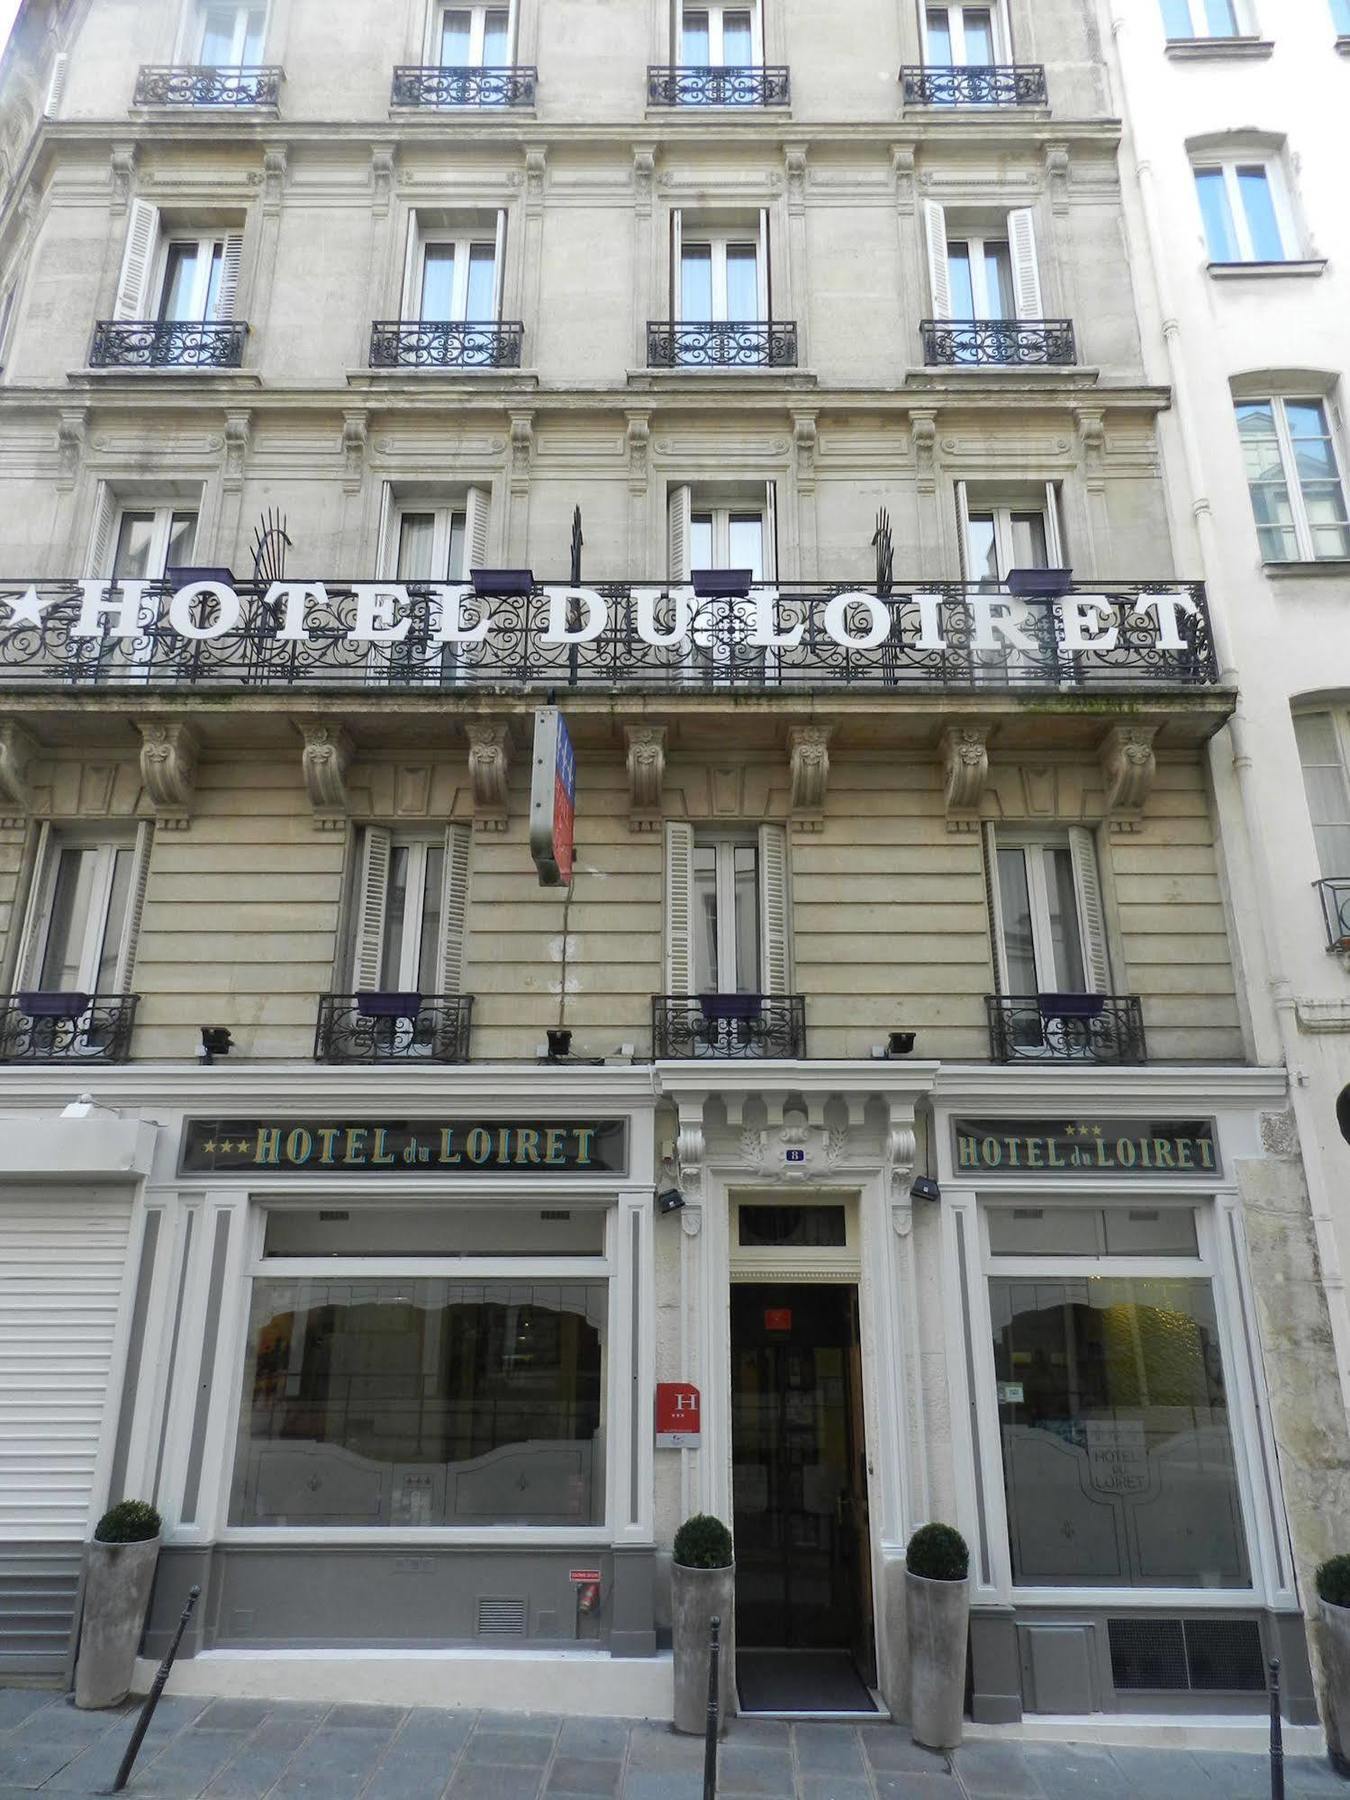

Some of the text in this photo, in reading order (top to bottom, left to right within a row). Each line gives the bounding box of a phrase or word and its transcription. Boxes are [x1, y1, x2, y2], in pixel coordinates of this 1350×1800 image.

[71, 579, 1197, 650] HOTEL DU LOIRET
[253, 1127, 595, 1164] HOTEL du LOIRET
[958, 1136, 1215, 1168] HOTEL du LOIRET
[674, 1393, 698, 1410] H
